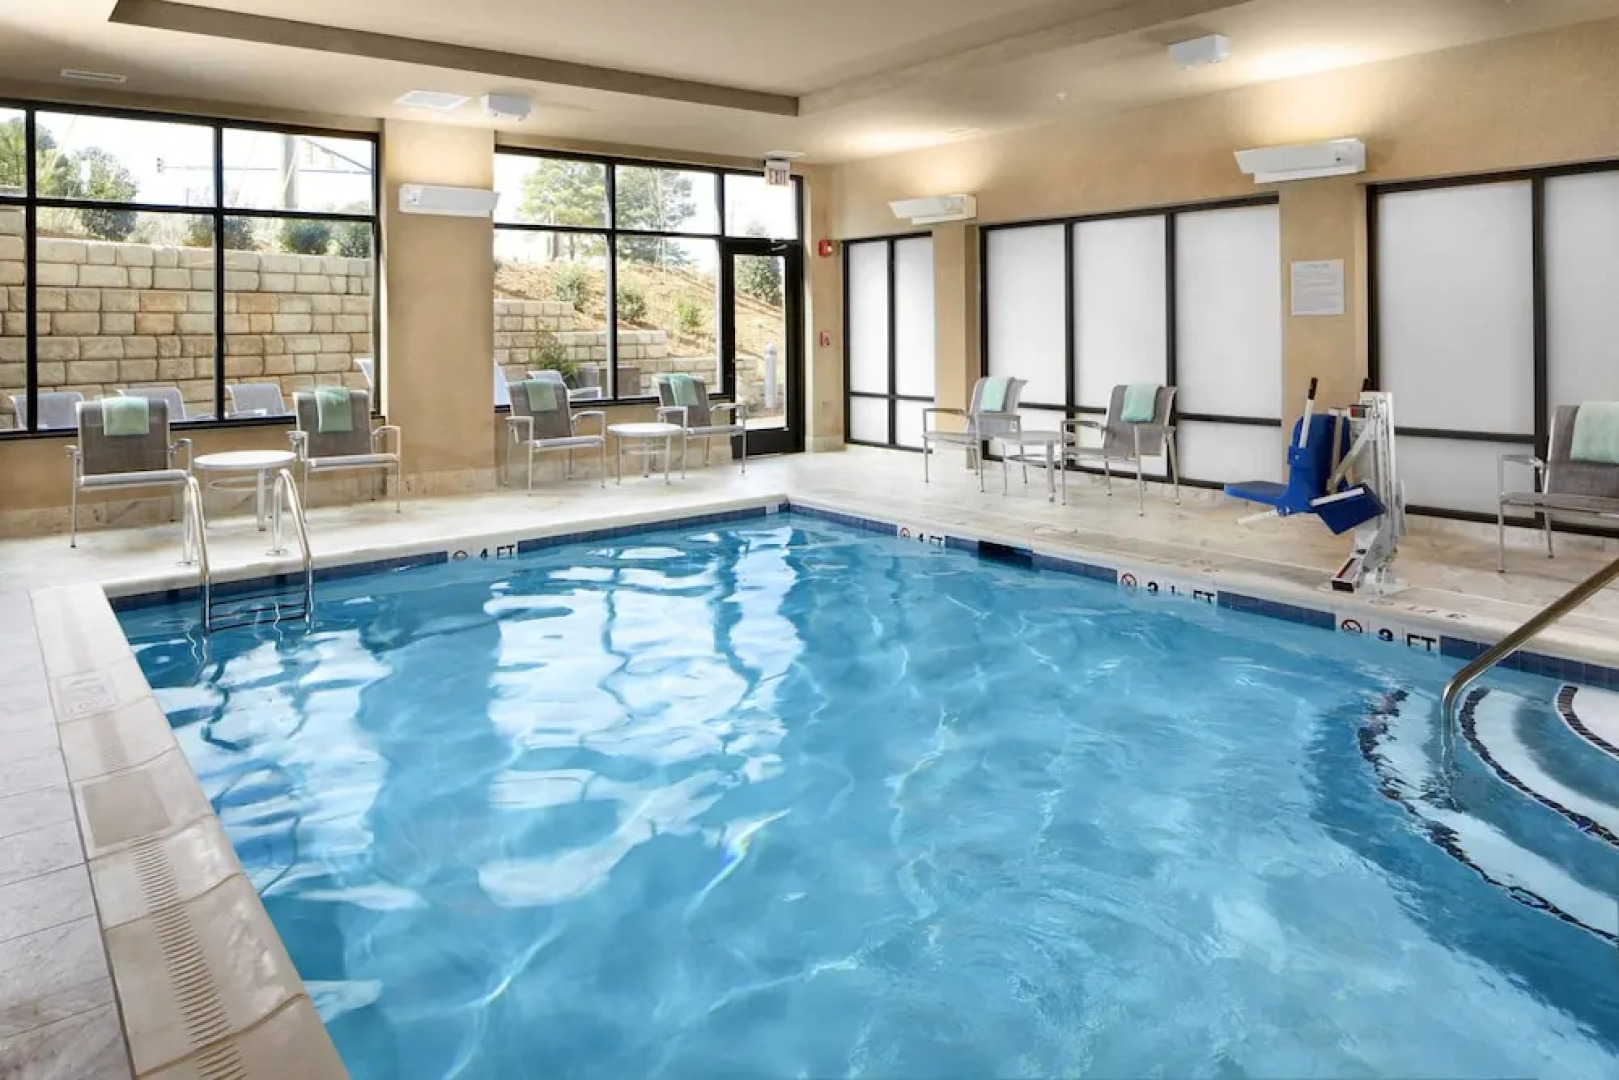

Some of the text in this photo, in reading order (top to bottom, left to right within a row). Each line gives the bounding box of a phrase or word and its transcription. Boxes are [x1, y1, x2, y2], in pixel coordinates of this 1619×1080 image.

[769, 169, 788, 185] EXIT
[497, 545, 515, 559] FT
[1407, 633, 1437, 652] FT
